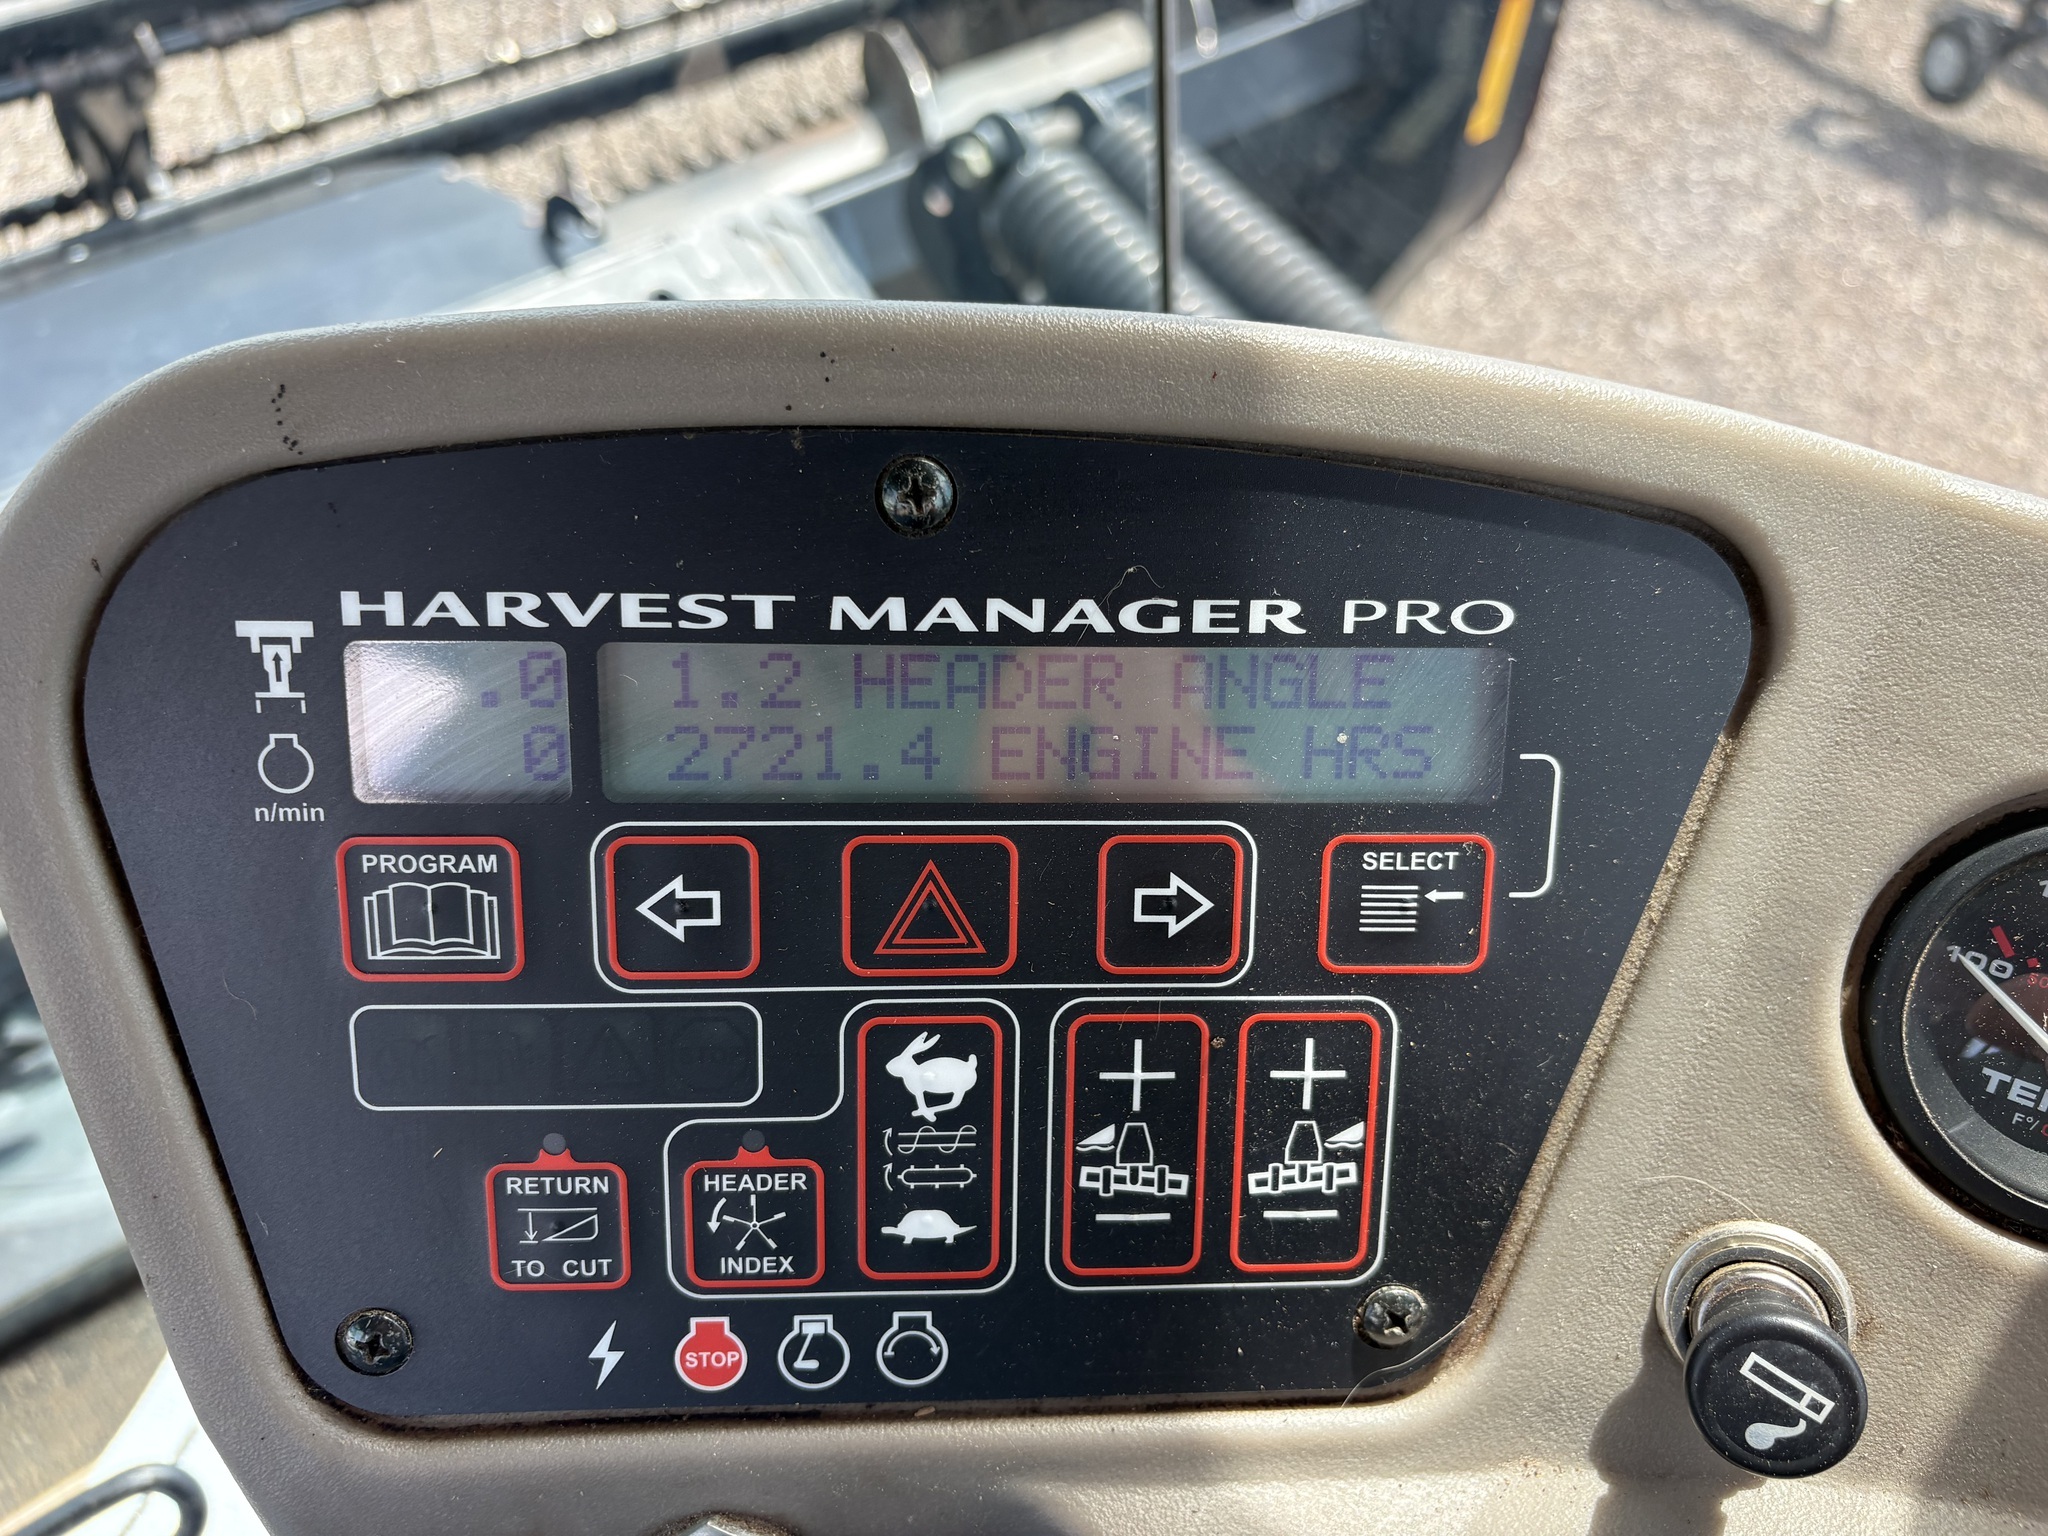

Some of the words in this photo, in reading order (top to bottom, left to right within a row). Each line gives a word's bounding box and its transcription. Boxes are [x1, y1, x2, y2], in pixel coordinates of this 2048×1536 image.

[339, 590, 796, 630] HARVEST
[829, 596, 1306, 636] MANAGER
[1343, 599, 1517, 636] PRO
[672, 652, 801, 709] 1.2
[853, 653, 1123, 710] HEADER
[1174, 653, 1396, 710] ANGLE
[523, 725, 566, 781] 0
[666, 725, 940, 781] 2721.4
[991, 725, 1256, 781] ENGINE
[1302, 725, 1435, 781] HRS
[254, 802, 325, 823] n/min
[362, 854, 498, 874] PROGRAM
[1361, 851, 1460, 871] SELECT
[1946, 944, 2014, 979] 100
[1981, 1066, 2048, 1113] TE
[506, 1176, 609, 1195] RETURN
[704, 1173, 808, 1192] HEADER
[512, 1260, 546, 1277] TO
[562, 1258, 613, 1277] CUT
[720, 1256, 795, 1274] INDEX
[685, 1351, 740, 1368] STOP
